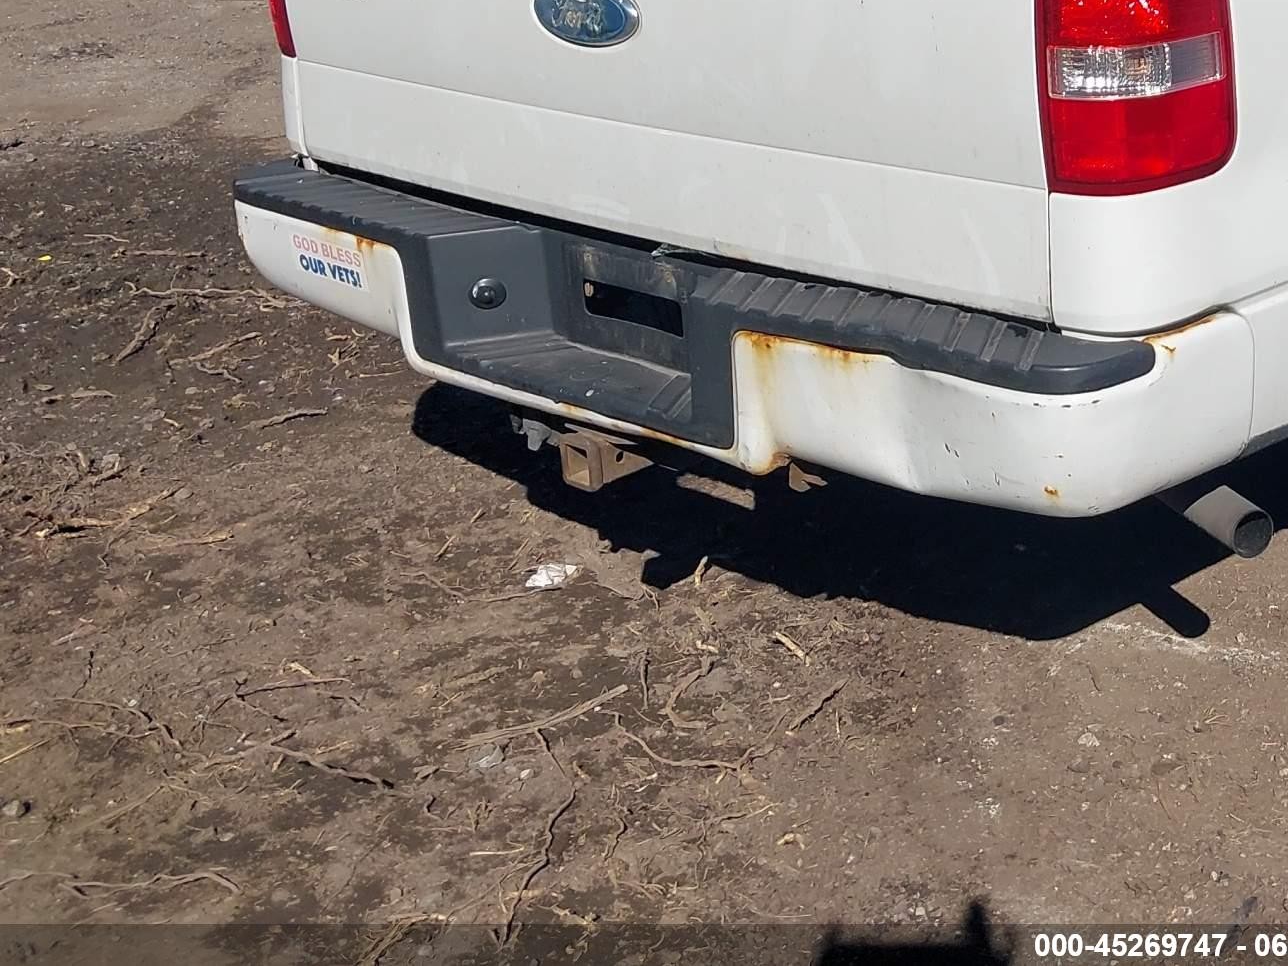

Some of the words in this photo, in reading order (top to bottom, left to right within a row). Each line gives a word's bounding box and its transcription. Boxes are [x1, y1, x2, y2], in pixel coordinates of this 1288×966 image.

[292, 234, 319, 254] GOD
[321, 242, 361, 268] BLESS
[299, 254, 327, 277] OUR
[327, 262, 363, 289] VETS!
